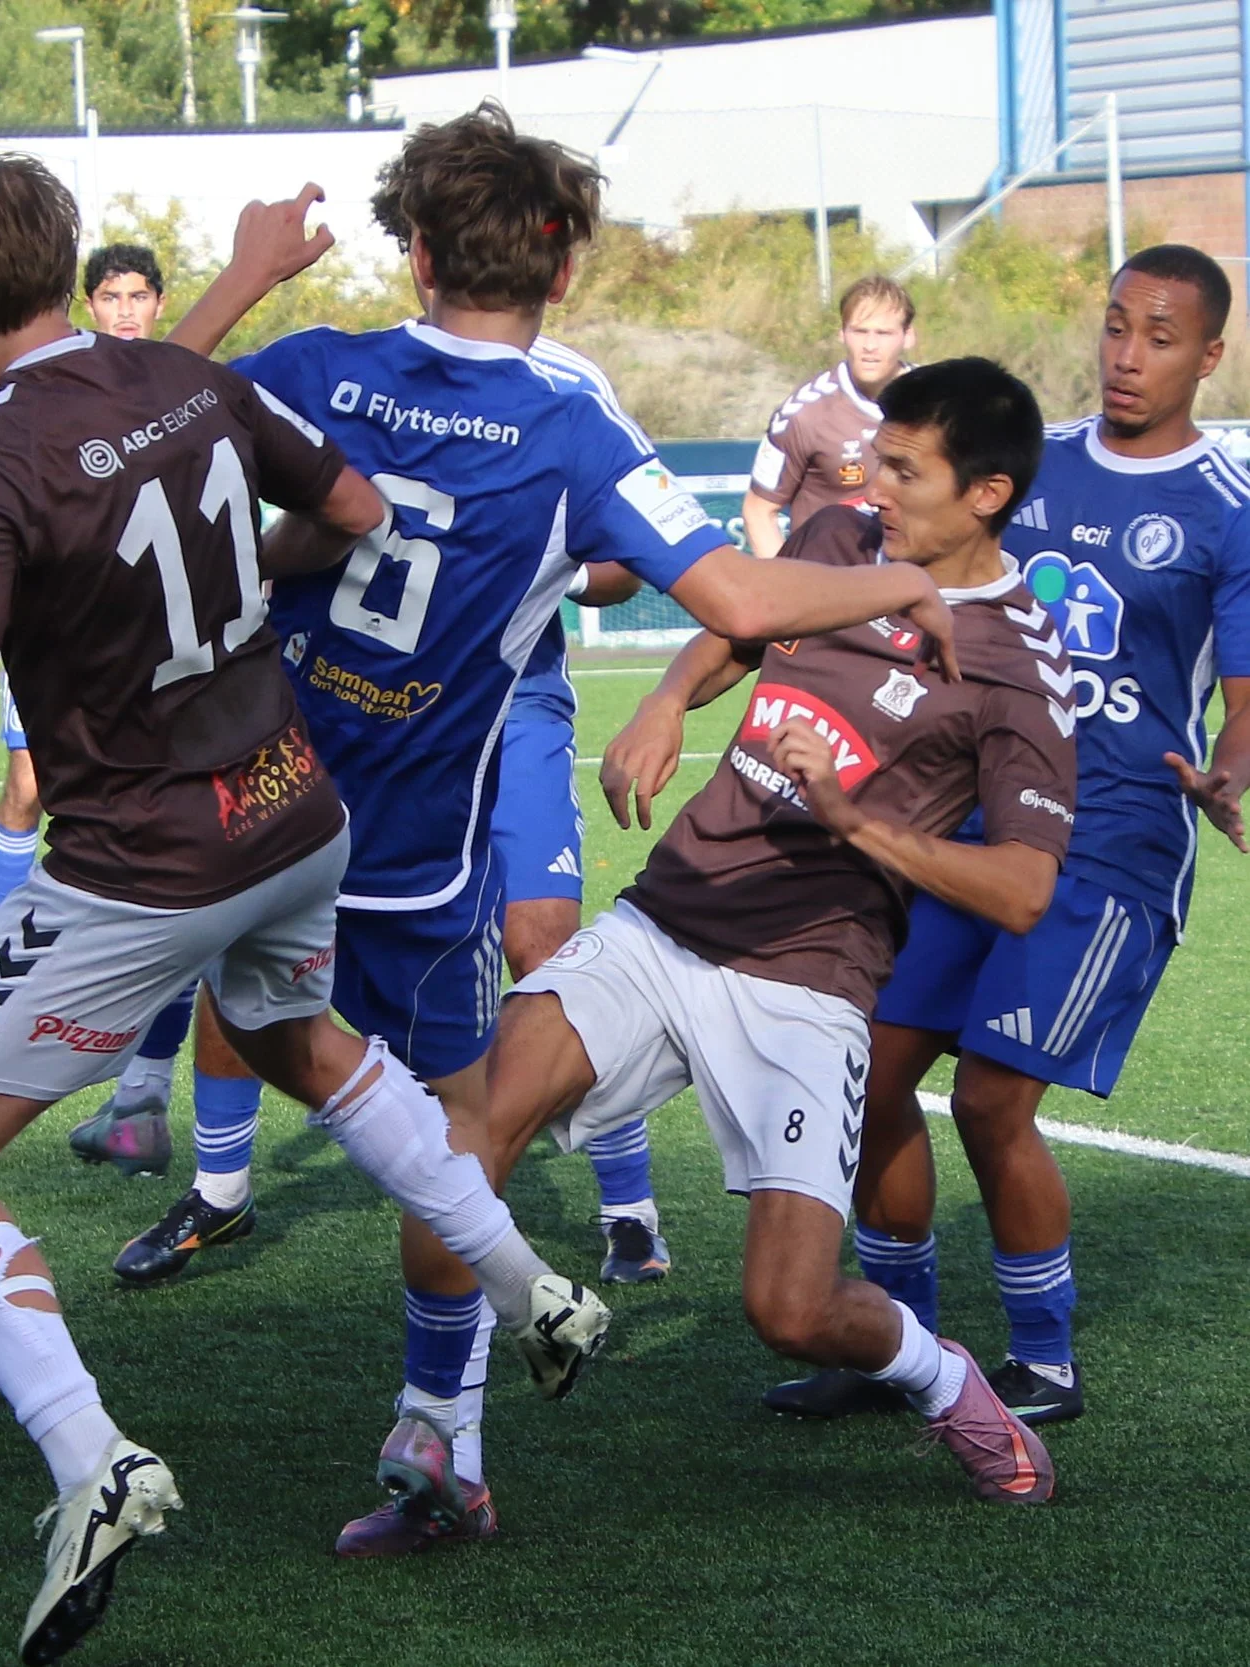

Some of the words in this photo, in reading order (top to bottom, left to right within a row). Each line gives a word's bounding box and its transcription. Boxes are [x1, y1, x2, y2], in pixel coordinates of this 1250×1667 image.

[121, 421, 164, 454] ABC
[161, 388, 218, 433] ELEKTRO
[1071, 522, 1113, 547] ecit
[115, 436, 270, 693] 11
[329, 472, 456, 655] 6
[309, 674, 333, 691] om
[333, 687, 361, 704] noe
[313, 655, 412, 709] Sammen
[1072, 669, 1143, 724] OS
[256, 797, 291, 821] WITH
[784, 1108, 806, 1144] 8
